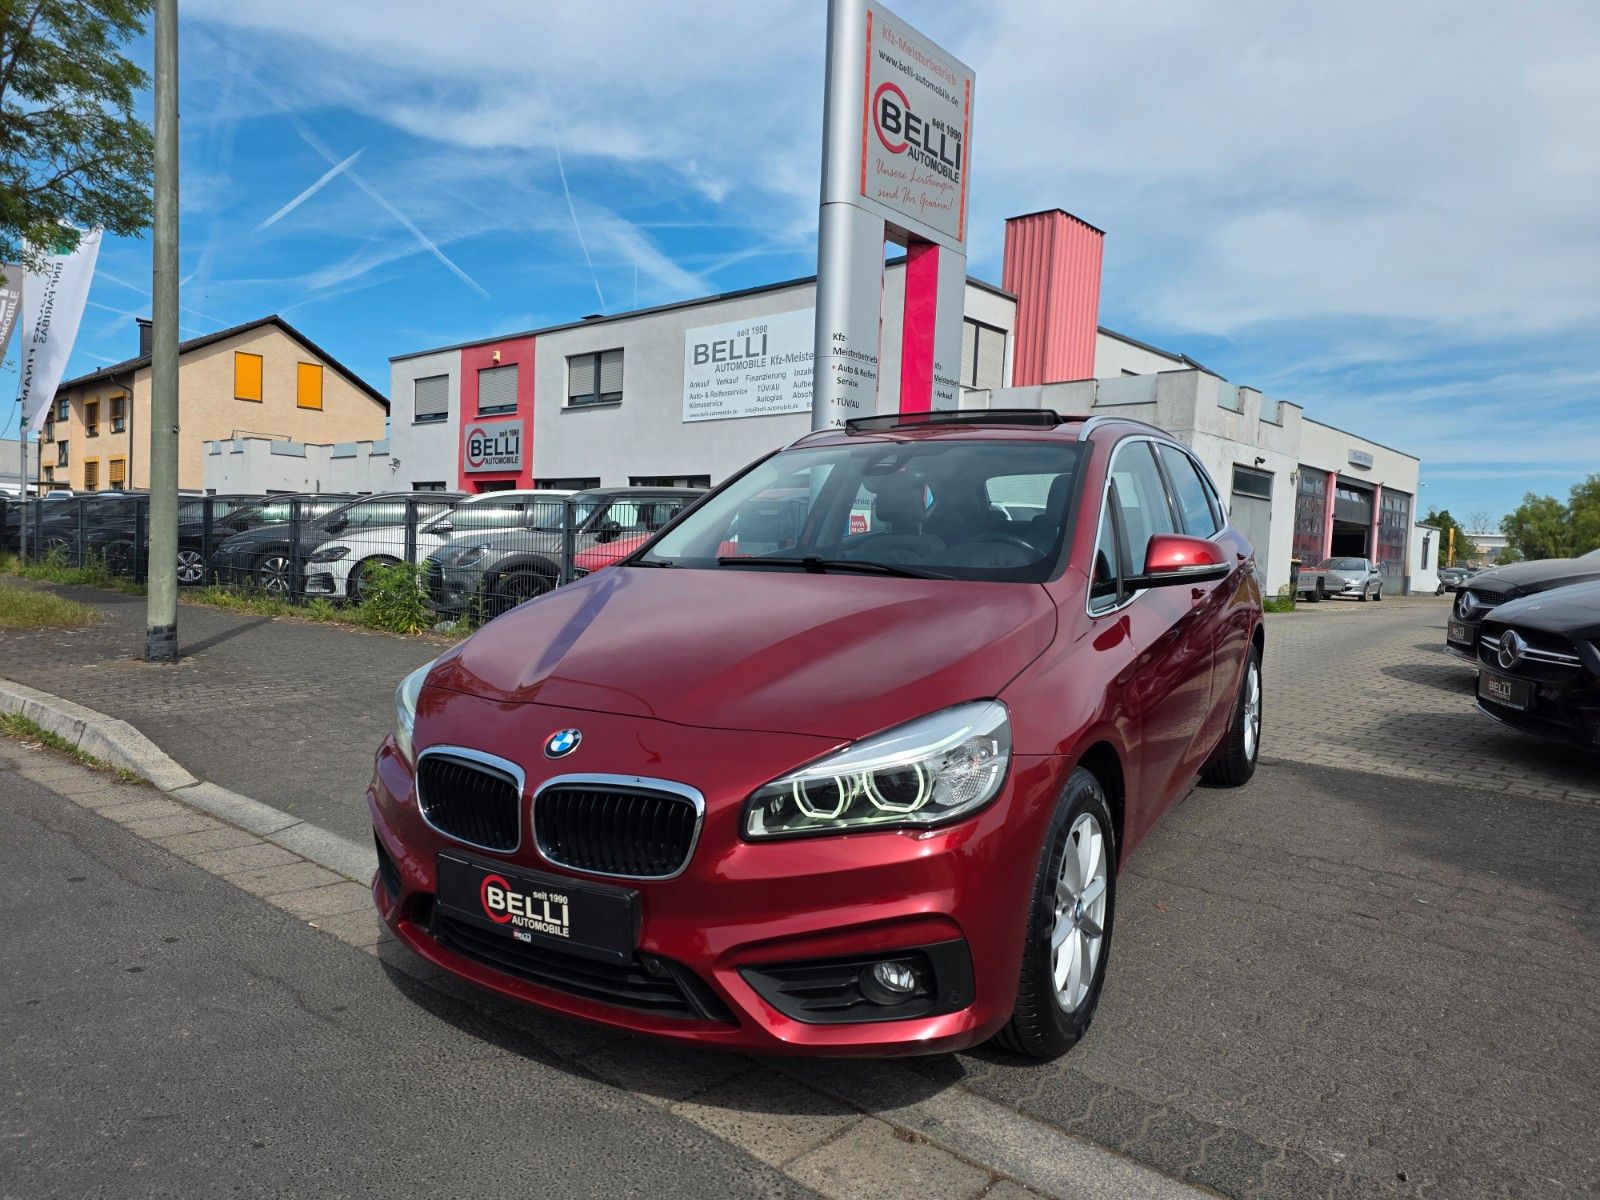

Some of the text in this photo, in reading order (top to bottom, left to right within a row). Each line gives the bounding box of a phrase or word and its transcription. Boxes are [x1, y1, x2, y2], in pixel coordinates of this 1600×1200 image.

[882, 26, 957, 86] Kfz-Meisterbetrieb
[879, 49, 960, 107] www.belli-automobile.de
[881, 97, 962, 170] BELLI
[932, 117, 962, 142] seit 1990
[876, 158, 907, 180] Unsere
[907, 146, 960, 184] AUTOMOBILE
[877, 187, 899, 200] sind
[736, 325, 768, 338] seit 1990
[832, 332, 848, 342] Kfz-
[693, 334, 767, 366] BELLI
[832, 346, 878, 364] Meisterbetrieb
[714, 358, 767, 373] AUTOMOBILE
[837, 364, 853, 374] Auto
[860, 369, 877, 380] Reifen
[689, 380, 710, 389] Ankauf
[716, 376, 739, 386] Verkauf
[745, 371, 787, 382] Finanzierung
[836, 376, 859, 388] Service
[689, 400, 724, 409] Klimaservice
[756, 394, 783, 403] Autoglas
[710, 388, 748, 398] Reifenservice
[470, 436, 519, 457] BELLI
[484, 456, 519, 465] AUTOMOBILE
[533, 890, 569, 904] seit 1990
[486, 886, 569, 927] BELLI
[511, 914, 570, 938] AUTOMOBILE
